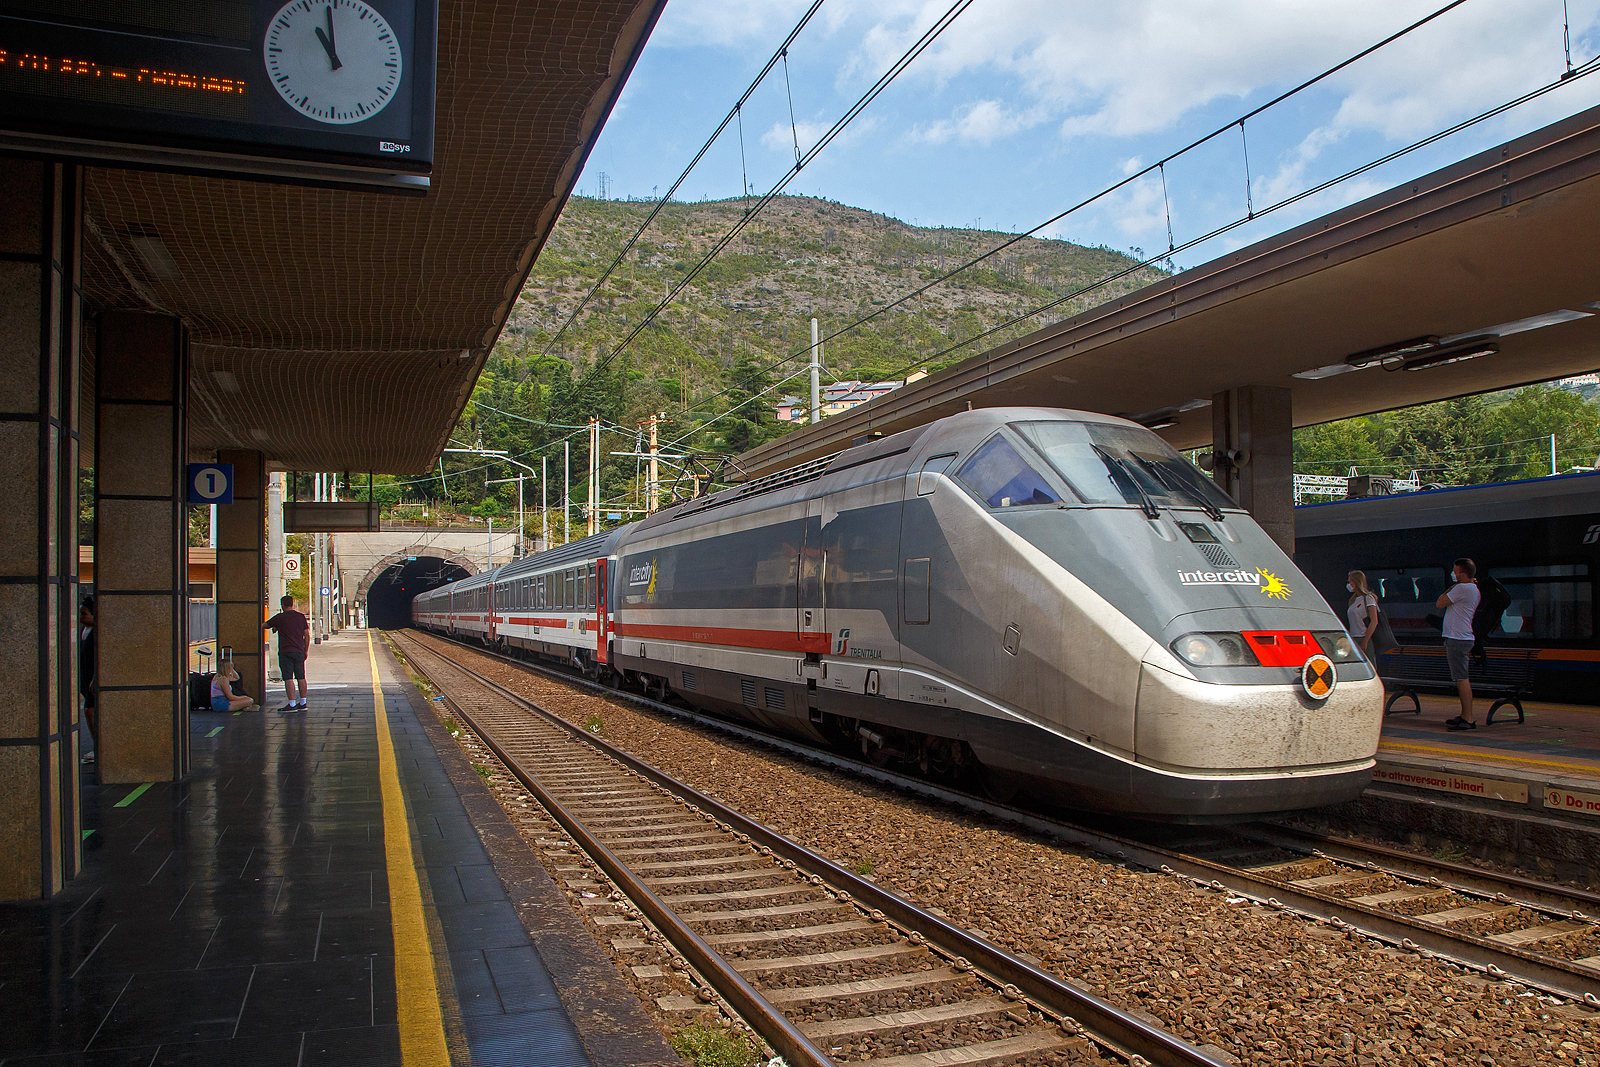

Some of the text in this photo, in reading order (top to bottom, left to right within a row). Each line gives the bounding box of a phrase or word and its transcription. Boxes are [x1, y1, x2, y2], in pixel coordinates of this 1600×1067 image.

[383, 142, 411, 154] aesys
[206, 473, 215, 493] 1
[630, 562, 654, 584] intercity
[1176, 568, 1261, 585] intercity
[850, 647, 882, 660] TRENITALIA
[1389, 771, 1447, 788] attraversare
[1449, 778, 1452, 788] i
[1454, 778, 1484, 793] binari
[1566, 794, 1583, 808] Do
